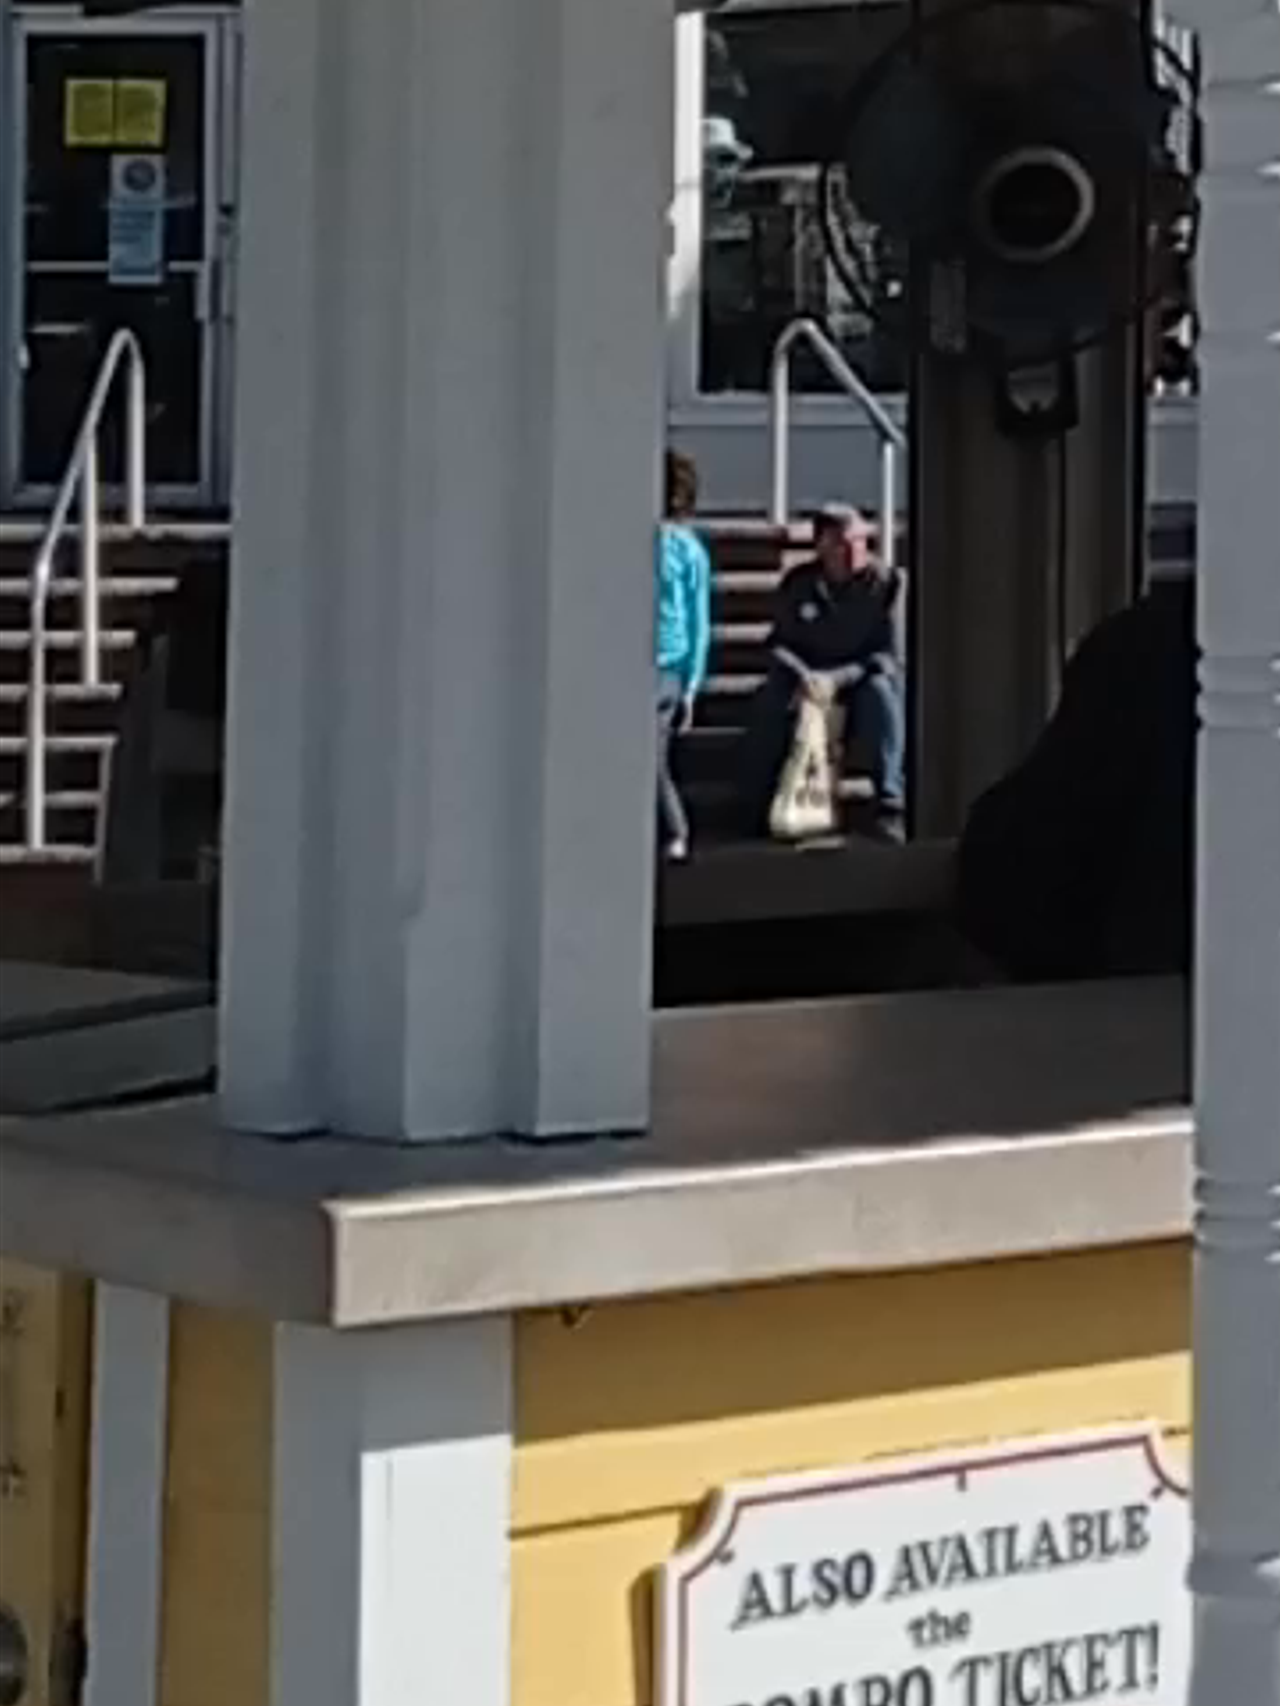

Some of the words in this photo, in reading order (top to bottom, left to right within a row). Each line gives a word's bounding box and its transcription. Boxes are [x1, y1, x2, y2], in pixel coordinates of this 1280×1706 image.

[731, 1550, 875, 1631] ALSO
[884, 1505, 1150, 1601] AVAILABLE
[907, 1608, 971, 1648] the
